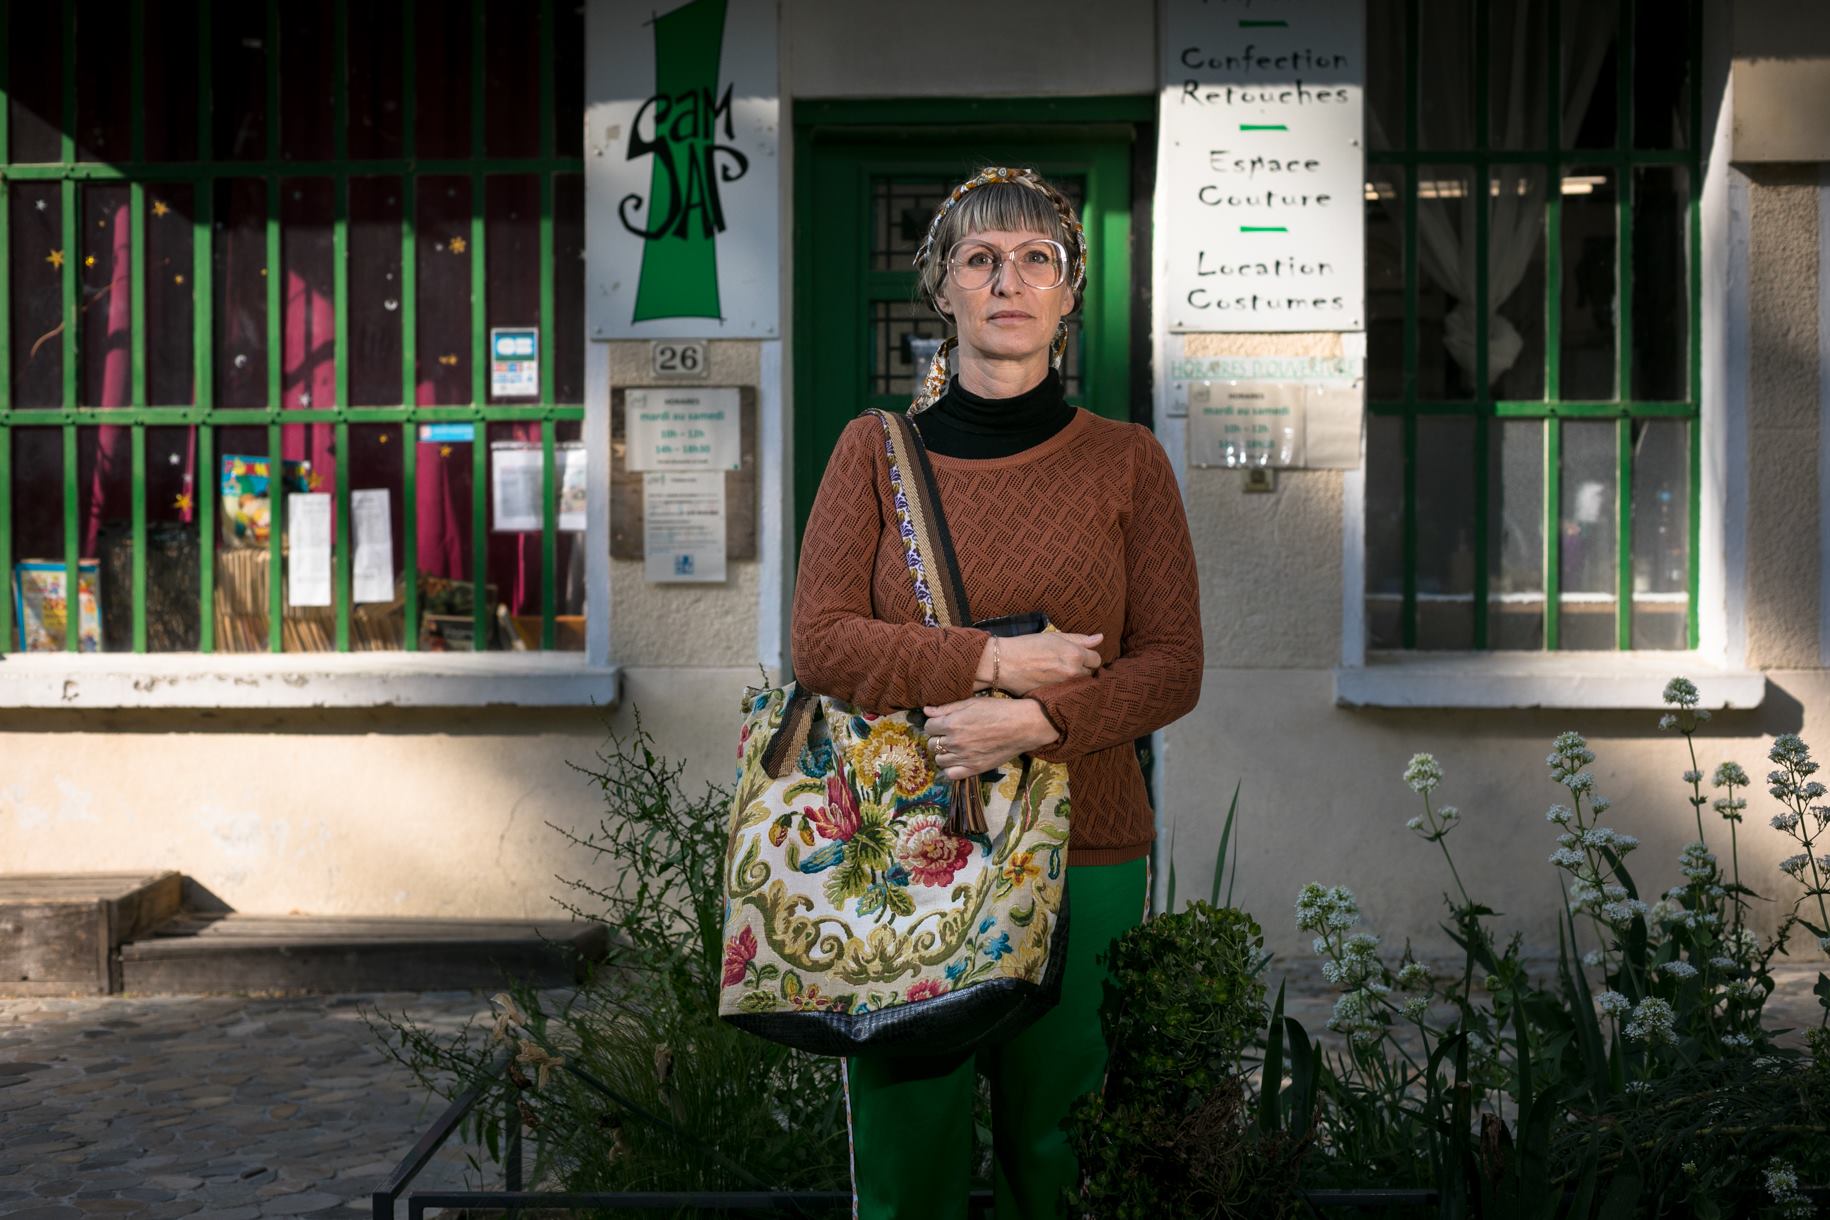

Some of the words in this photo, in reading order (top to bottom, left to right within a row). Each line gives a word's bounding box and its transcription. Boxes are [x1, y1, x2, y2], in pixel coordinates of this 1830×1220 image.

[1181, 44, 1348, 73] Confection
[1181, 78, 1349, 105] Retouches
[1210, 150, 1320, 179] Espace
[1199, 185, 1331, 207] Couture
[1198, 251, 1334, 276] Location
[1187, 288, 1344, 310] Costumes
[659, 346, 698, 370] 26
[640, 410, 669, 421] mardi
[688, 410, 724, 421] samedi
